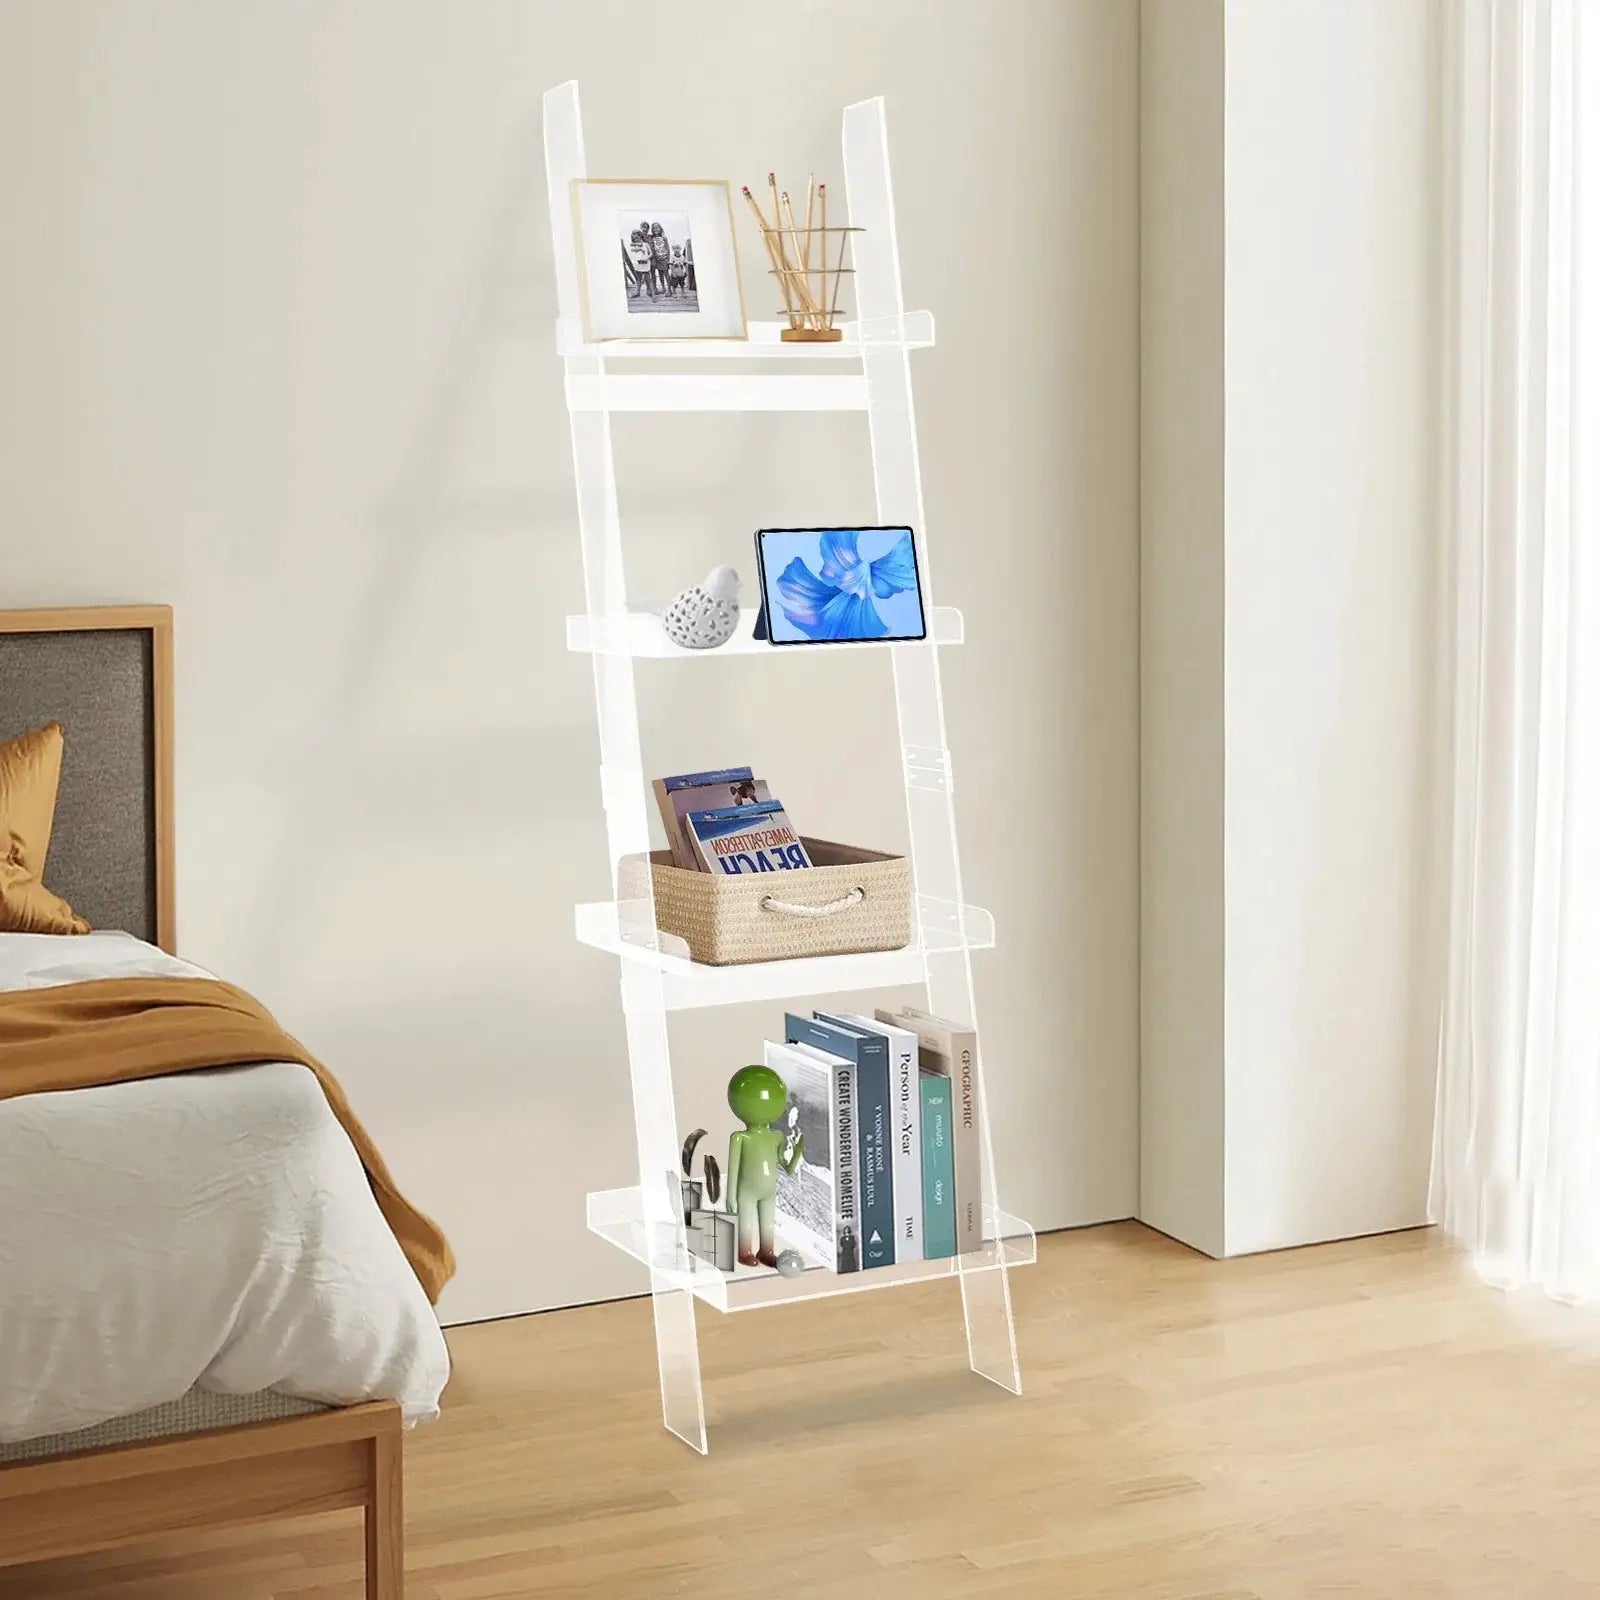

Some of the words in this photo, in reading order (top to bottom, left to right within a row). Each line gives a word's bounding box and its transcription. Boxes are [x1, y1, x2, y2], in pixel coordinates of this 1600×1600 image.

[838, 1070, 850, 1105] CREATE
[900, 1053, 911, 1102] Person
[839, 1107, 852, 1168] WONDERFUL
[902, 1124, 912, 1156] Year
[935, 1115, 943, 1147] muuto
[840, 1171, 853, 1220] HOMELIFE
[934, 1180, 943, 1206] design
